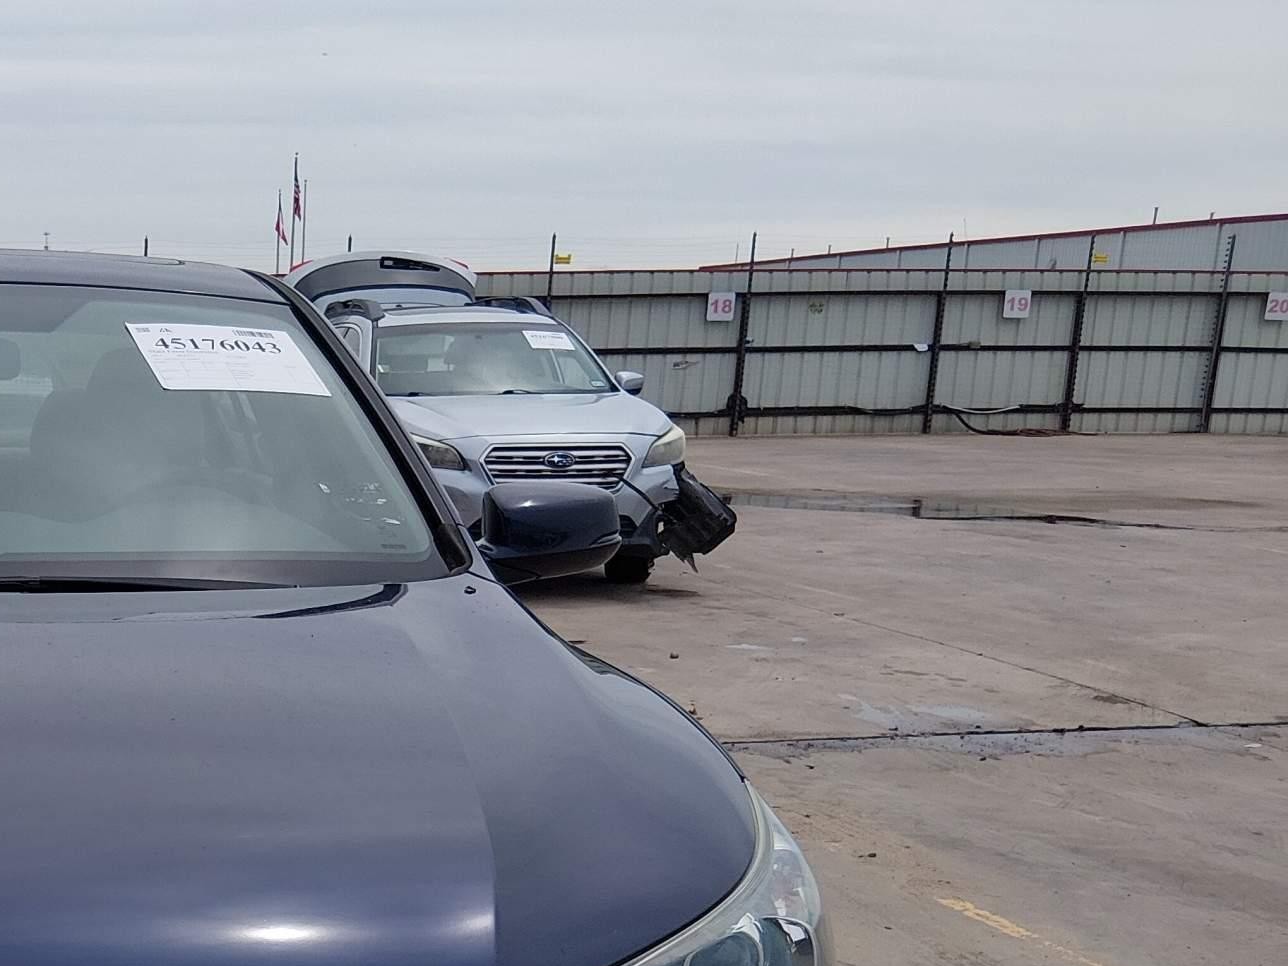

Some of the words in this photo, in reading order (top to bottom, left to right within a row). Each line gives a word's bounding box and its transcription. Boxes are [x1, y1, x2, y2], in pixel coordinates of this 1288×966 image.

[711, 299, 732, 314] 18
[1007, 297, 1028, 312] 19
[1267, 299, 1288, 313] 20
[154, 337, 282, 354] 45176043
